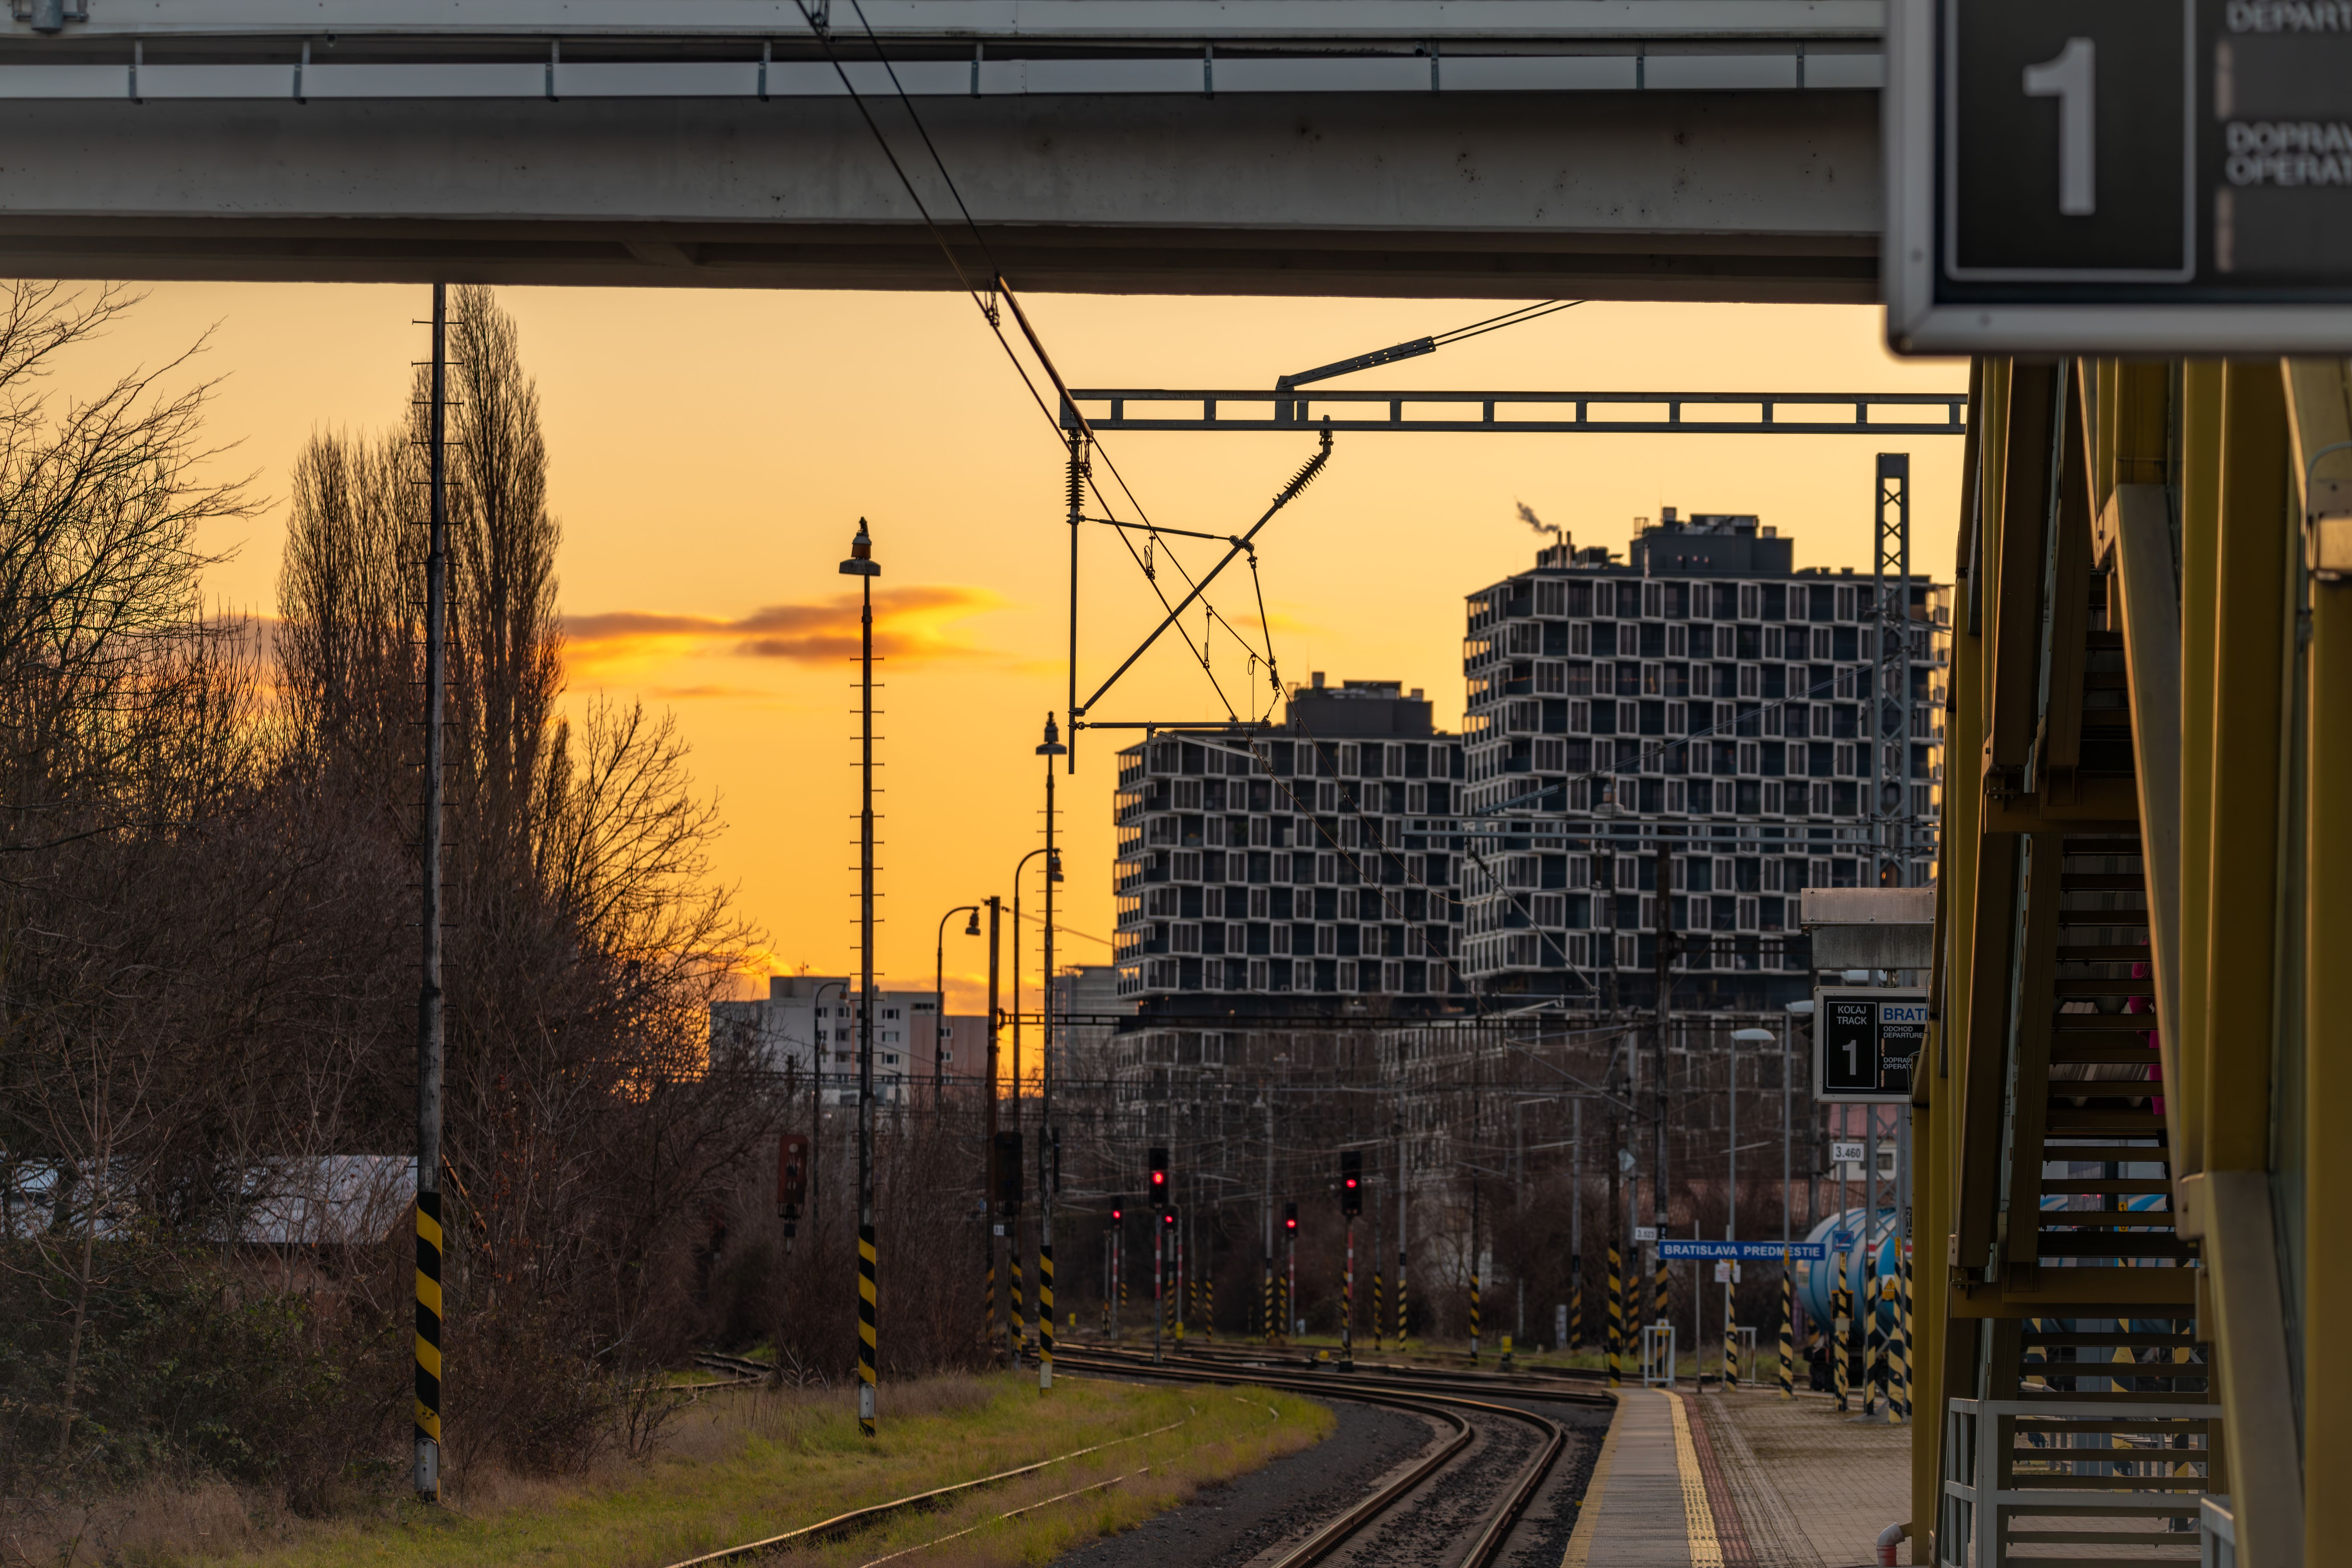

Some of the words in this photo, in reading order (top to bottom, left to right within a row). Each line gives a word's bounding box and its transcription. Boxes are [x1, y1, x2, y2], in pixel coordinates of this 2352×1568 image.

[2023, 37, 2095, 215] 1
[1842, 1040, 1856, 1075] 1
[1836, 1146, 1861, 1158] 3.460
[1664, 1245, 1738, 1255] BRATISLAVA
[1743, 1246, 1820, 1257] PREDMESTIE
